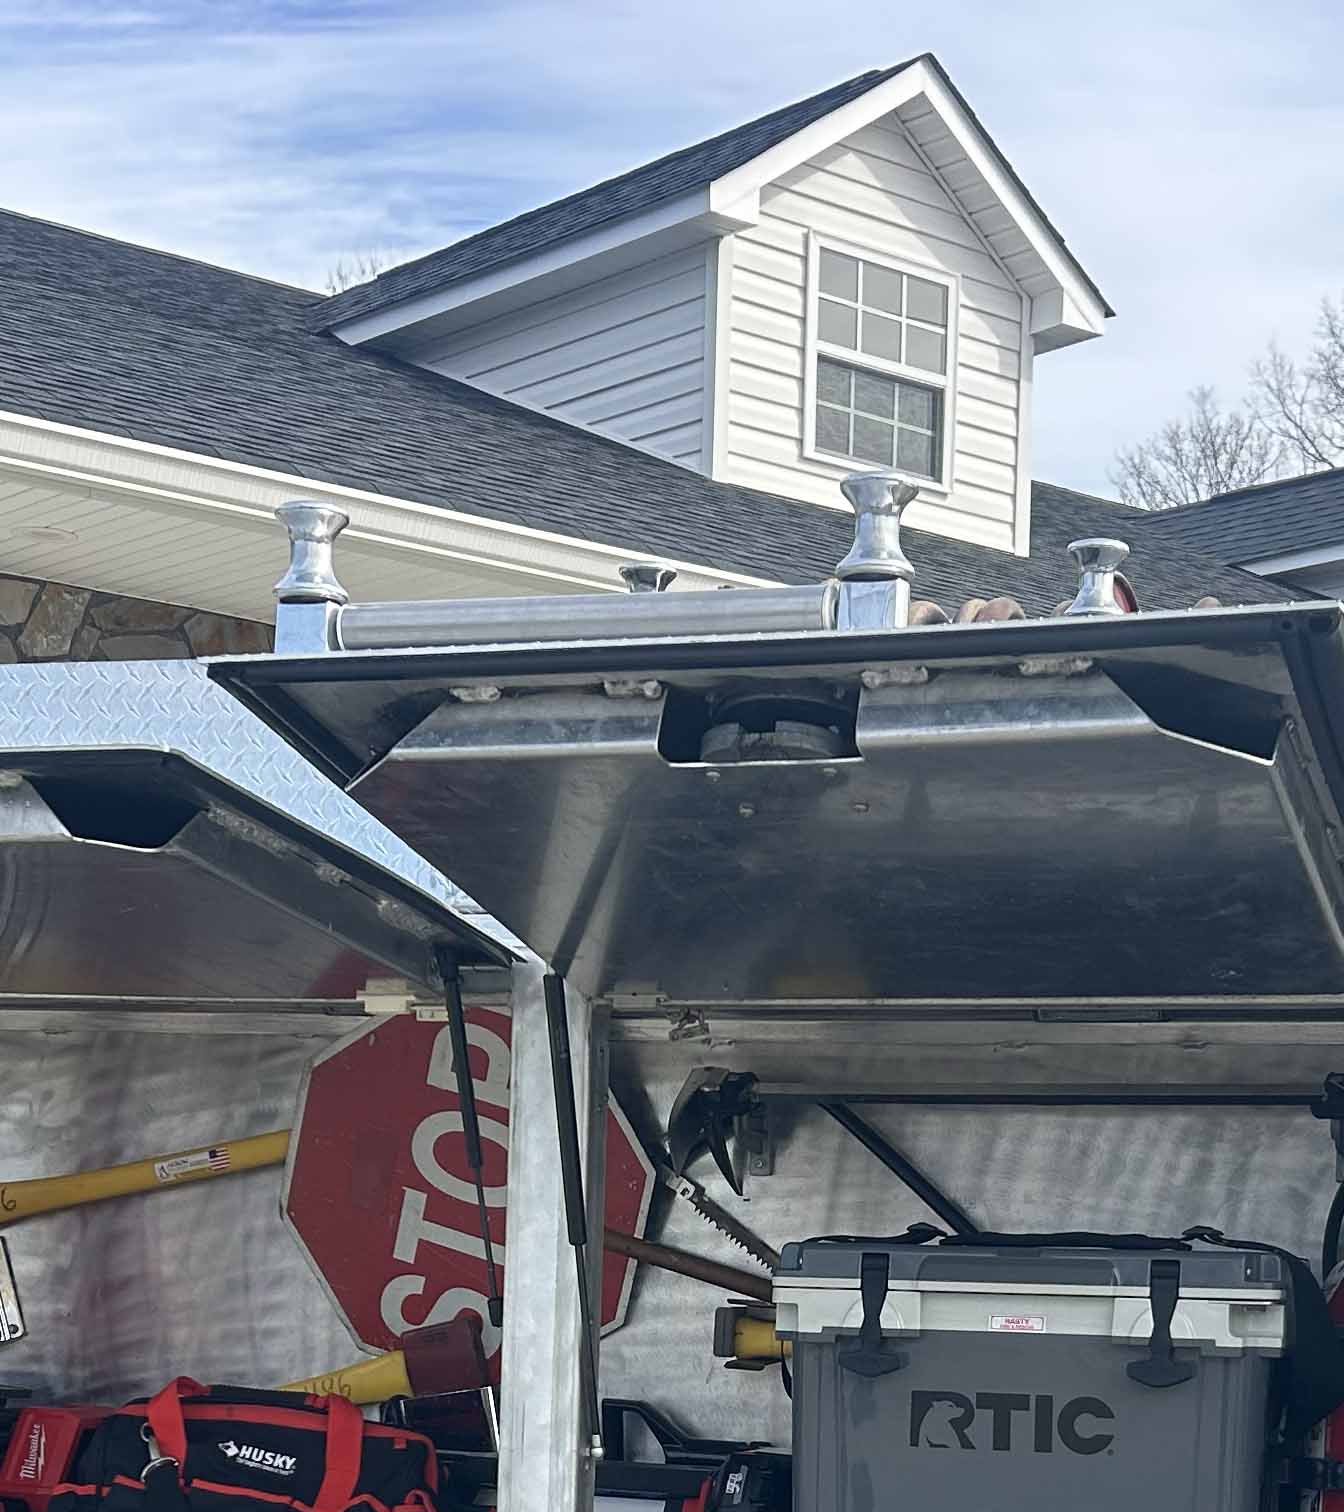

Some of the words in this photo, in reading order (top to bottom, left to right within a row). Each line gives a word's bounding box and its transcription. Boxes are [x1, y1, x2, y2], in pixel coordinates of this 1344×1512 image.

[379, 1022, 511, 1360] STOP
[19, 1423, 42, 1480] Milwaukee
[910, 1390, 1115, 1455] RTIC
[239, 1445, 297, 1470] HUSKY
